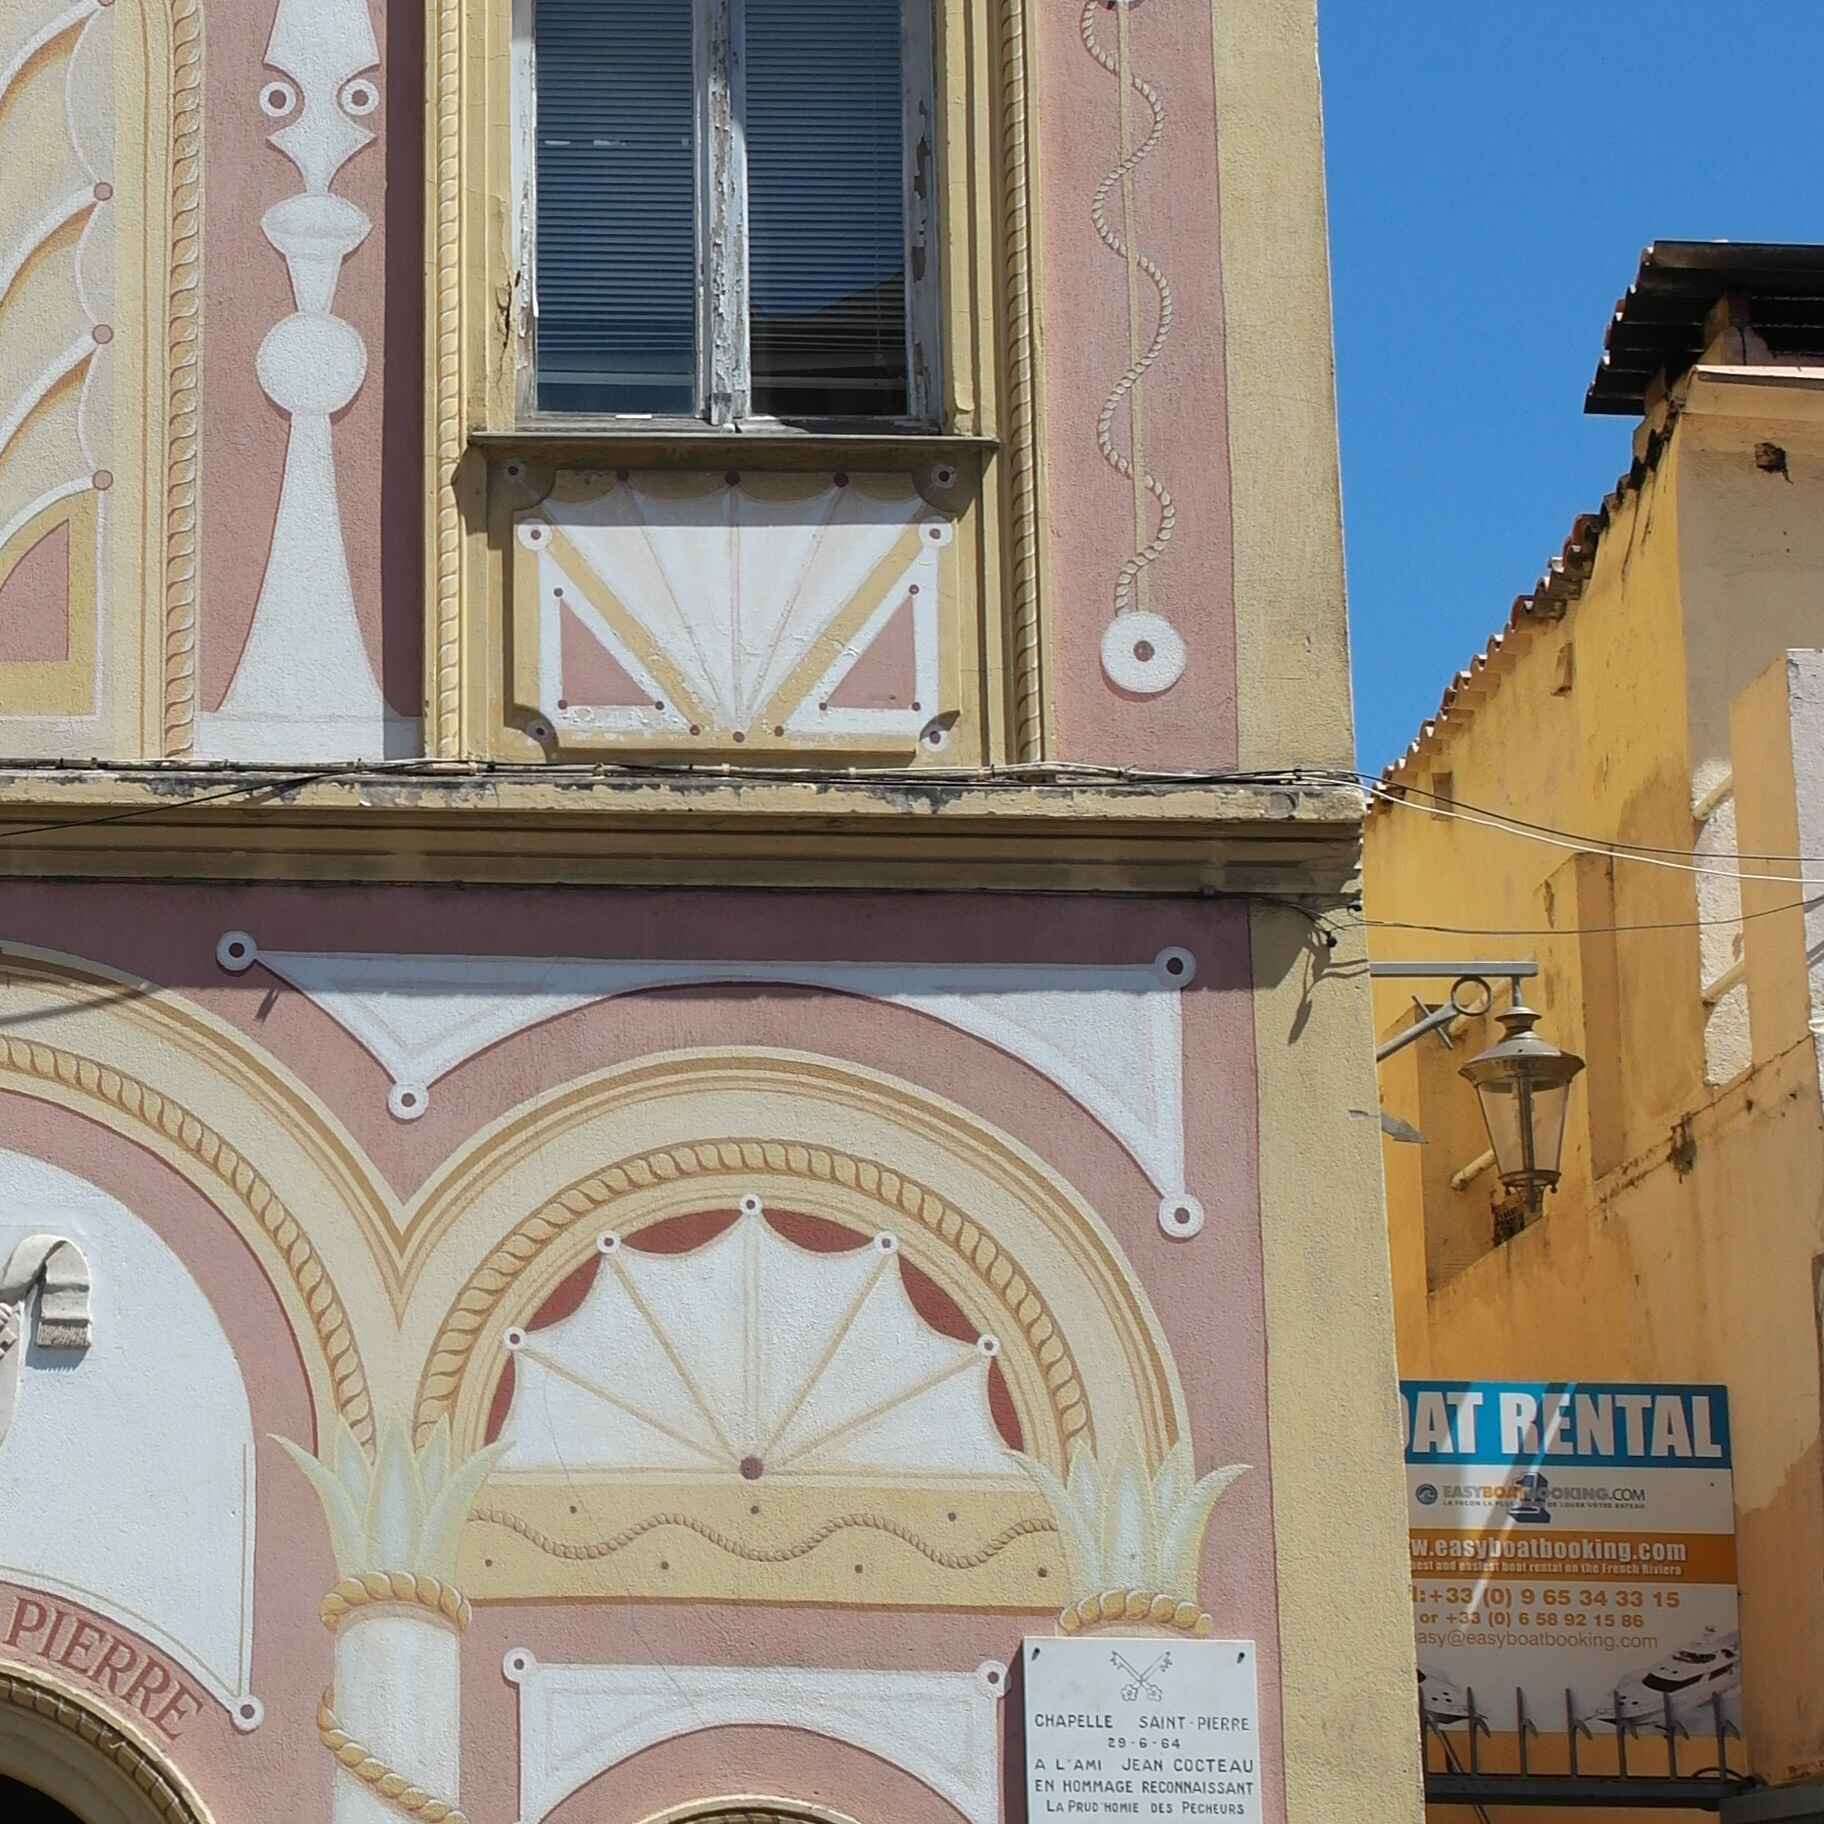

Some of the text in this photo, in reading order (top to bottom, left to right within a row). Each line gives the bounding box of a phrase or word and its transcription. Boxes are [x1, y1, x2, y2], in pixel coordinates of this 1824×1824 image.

[1498, 1392, 1723, 1458] RENTAL
[1442, 1485, 1646, 1502] EASYBOATOOKING.COM
[1501, 1561, 1527, 1573] boat
[1529, 1562, 1563, 1574] rental
[1581, 1562, 1600, 1575] the
[1602, 1563, 1639, 1575] French
[1642, 1564, 1682, 1576] Riviera
[1483, 1588, 1512, 1608] (0)
[1520, 1588, 1535, 1606] 9
[1543, 1589, 1571, 1606] 65
[1579, 1590, 1608, 1607] 34
[1616, 1590, 1643, 1608] 33
[1653, 1591, 1681, 1608] 15
[1419, 1612, 1644, 1627] or +33 (0) 6 58 92 15 86
[1416, 1631, 1658, 1651] asy@easyboatbooking.com
[2, 1596, 204, 1742] PIERRE
[1034, 1714, 1113, 1728] CHAPELLE
[1034, 1758, 1046, 1770] A
[1121, 1758, 1163, 1772] JEAN
[1173, 1758, 1254, 1773] COCTEAU
[1035, 1779, 1254, 1795] EN HOMMAGE RECONNAISSANT
[1046, 1799, 1064, 1813] LA
[1151, 1803, 1173, 1814] DES
[1182, 1801, 1245, 1815] PECHEURS
